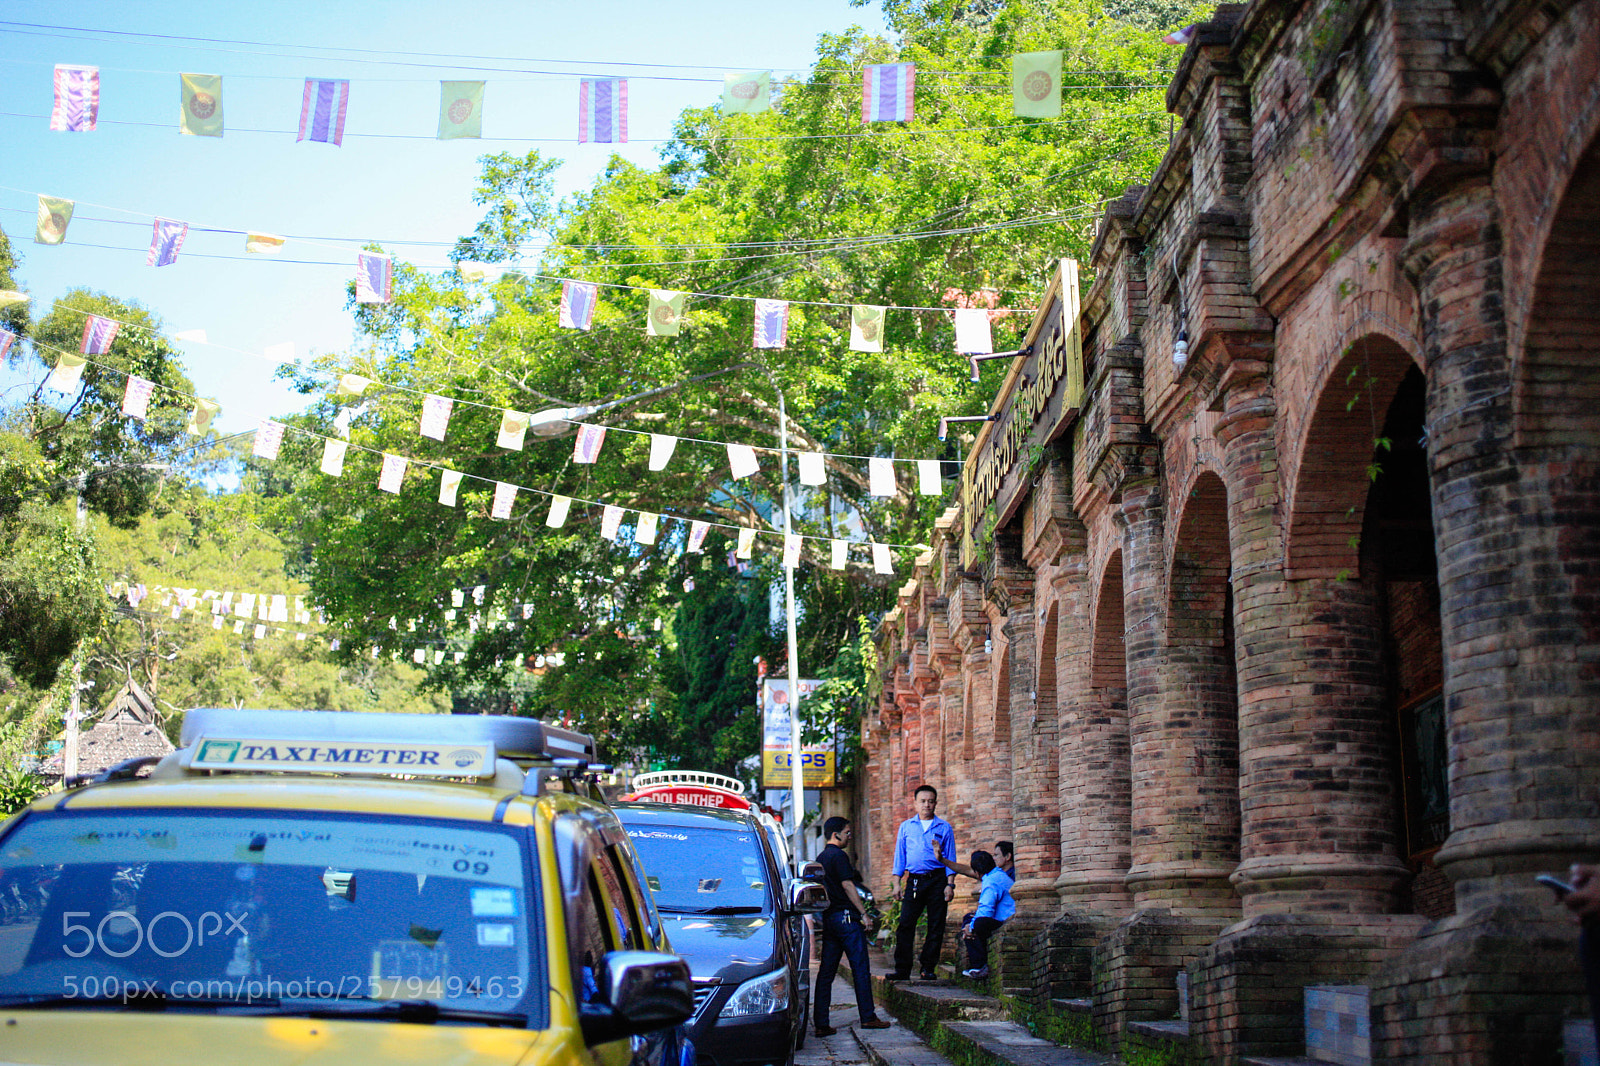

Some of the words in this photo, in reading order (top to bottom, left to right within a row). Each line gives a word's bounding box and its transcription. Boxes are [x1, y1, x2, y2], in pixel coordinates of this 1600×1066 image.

[241, 744, 441, 767] TAXI-METER
[675, 793, 724, 808] SUTHEP
[452, 859, 490, 876] 09
